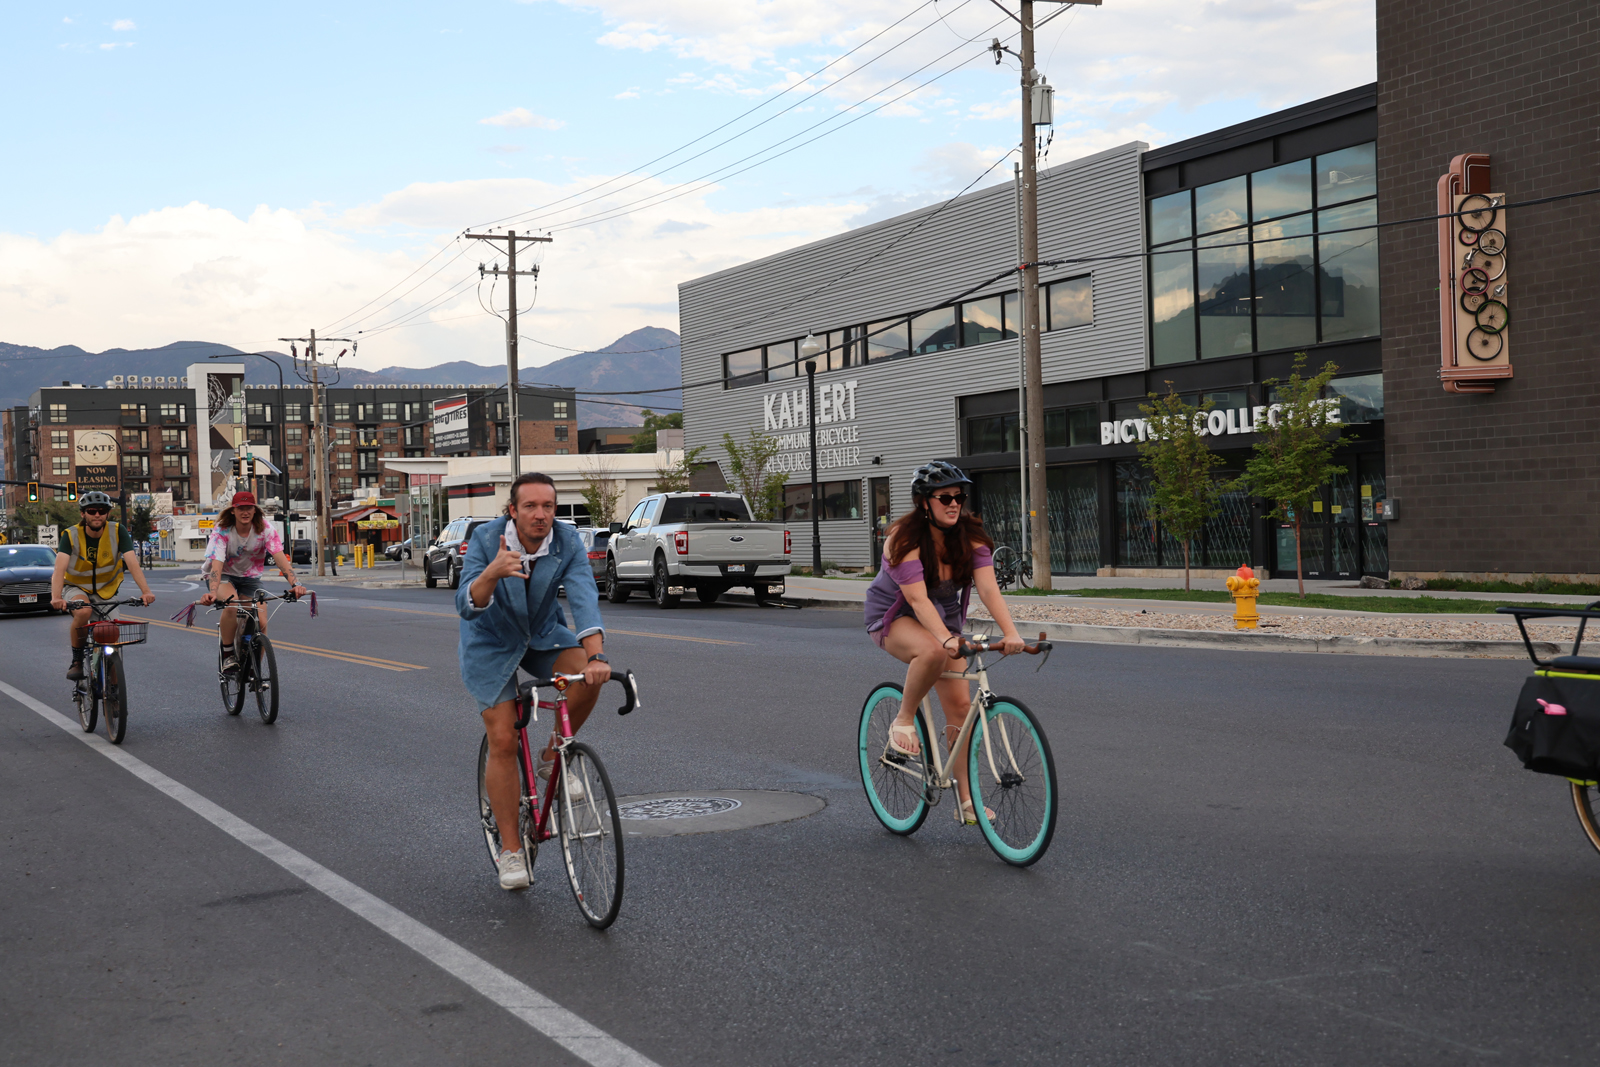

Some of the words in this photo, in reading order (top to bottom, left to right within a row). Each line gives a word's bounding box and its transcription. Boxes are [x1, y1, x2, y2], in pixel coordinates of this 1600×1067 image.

[435, 413, 444, 424] BIG
[449, 409, 467, 421] TIRES
[764, 380, 857, 430] KAHERT
[1192, 397, 1341, 436] COLLECTVE
[766, 431, 819, 451] COMMUNIY
[820, 426, 859, 446] BICYCLE
[766, 451, 812, 472] RESOURC
[819, 446, 860, 469] CENTER
